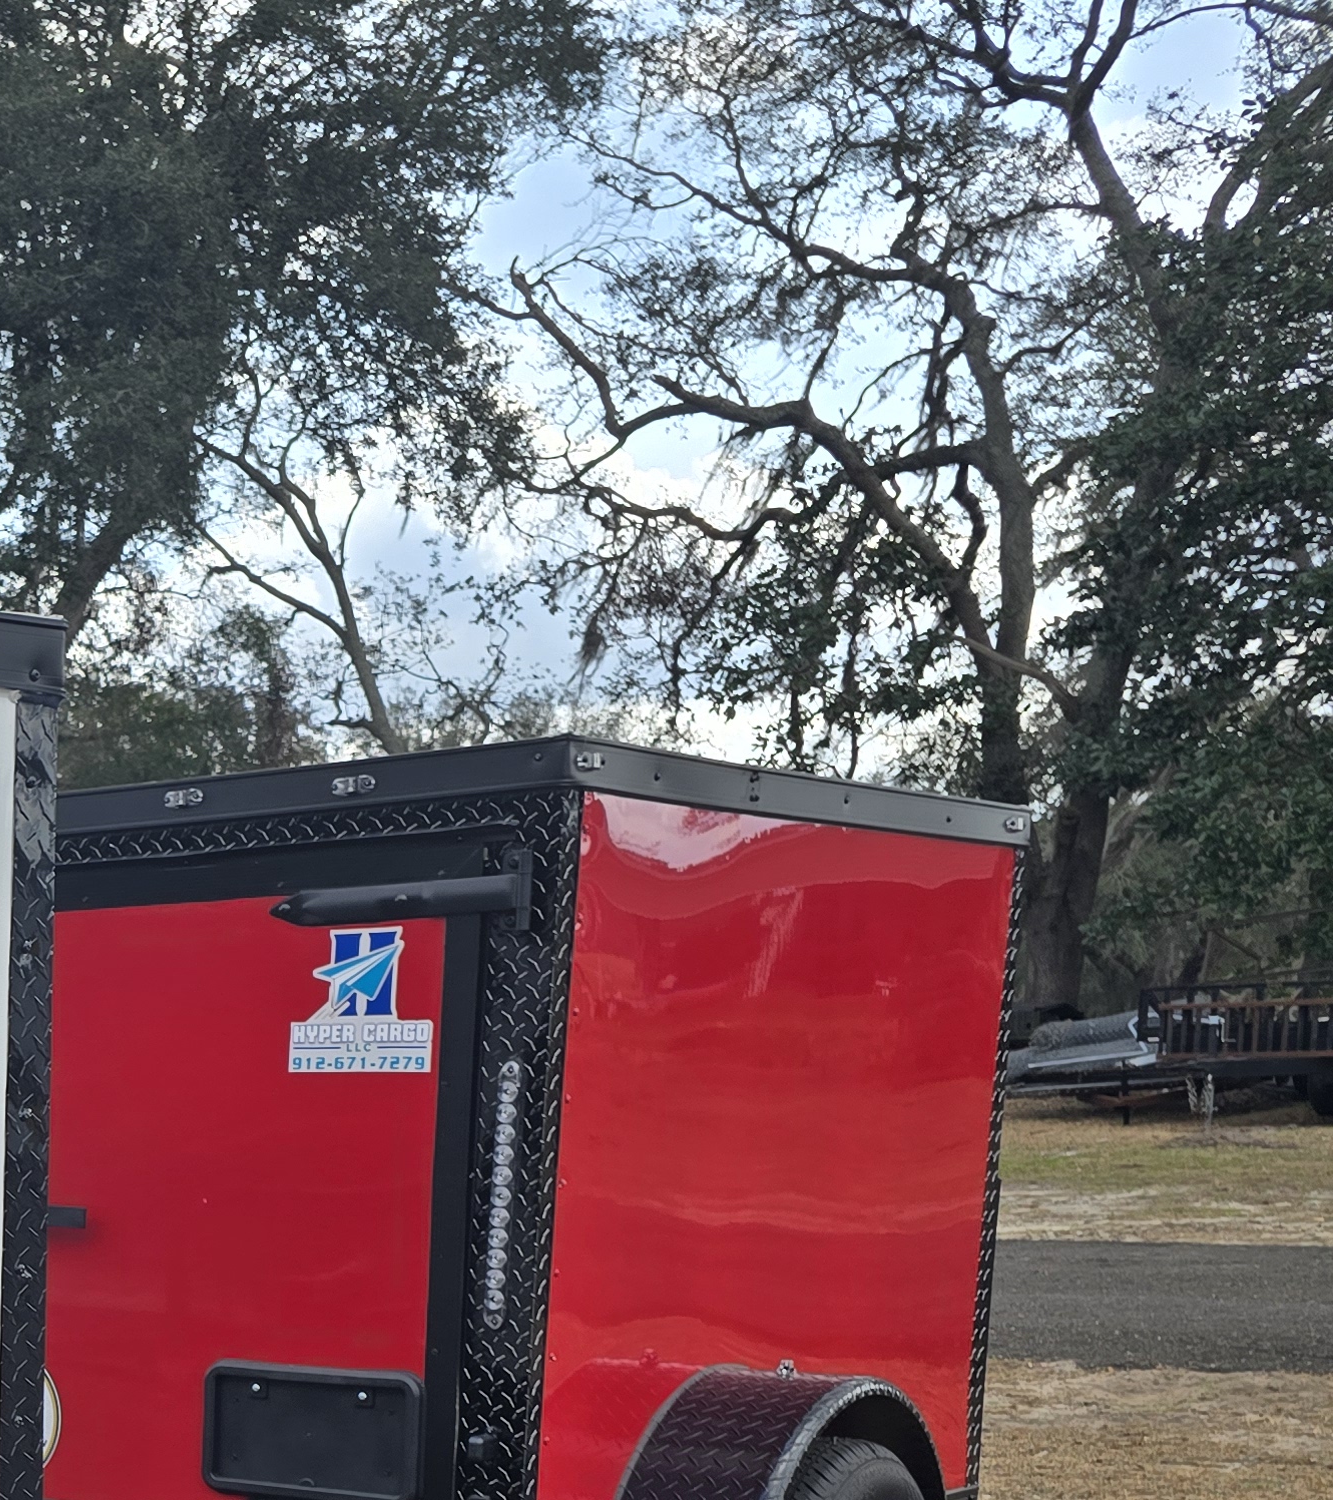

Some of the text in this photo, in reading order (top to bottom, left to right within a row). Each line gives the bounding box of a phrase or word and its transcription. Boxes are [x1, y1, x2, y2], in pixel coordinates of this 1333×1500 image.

[293, 1023, 430, 1043] HYPER CARGO
[346, 1043, 372, 1053] LLC
[293, 1056, 425, 1070] 912-671-7279
